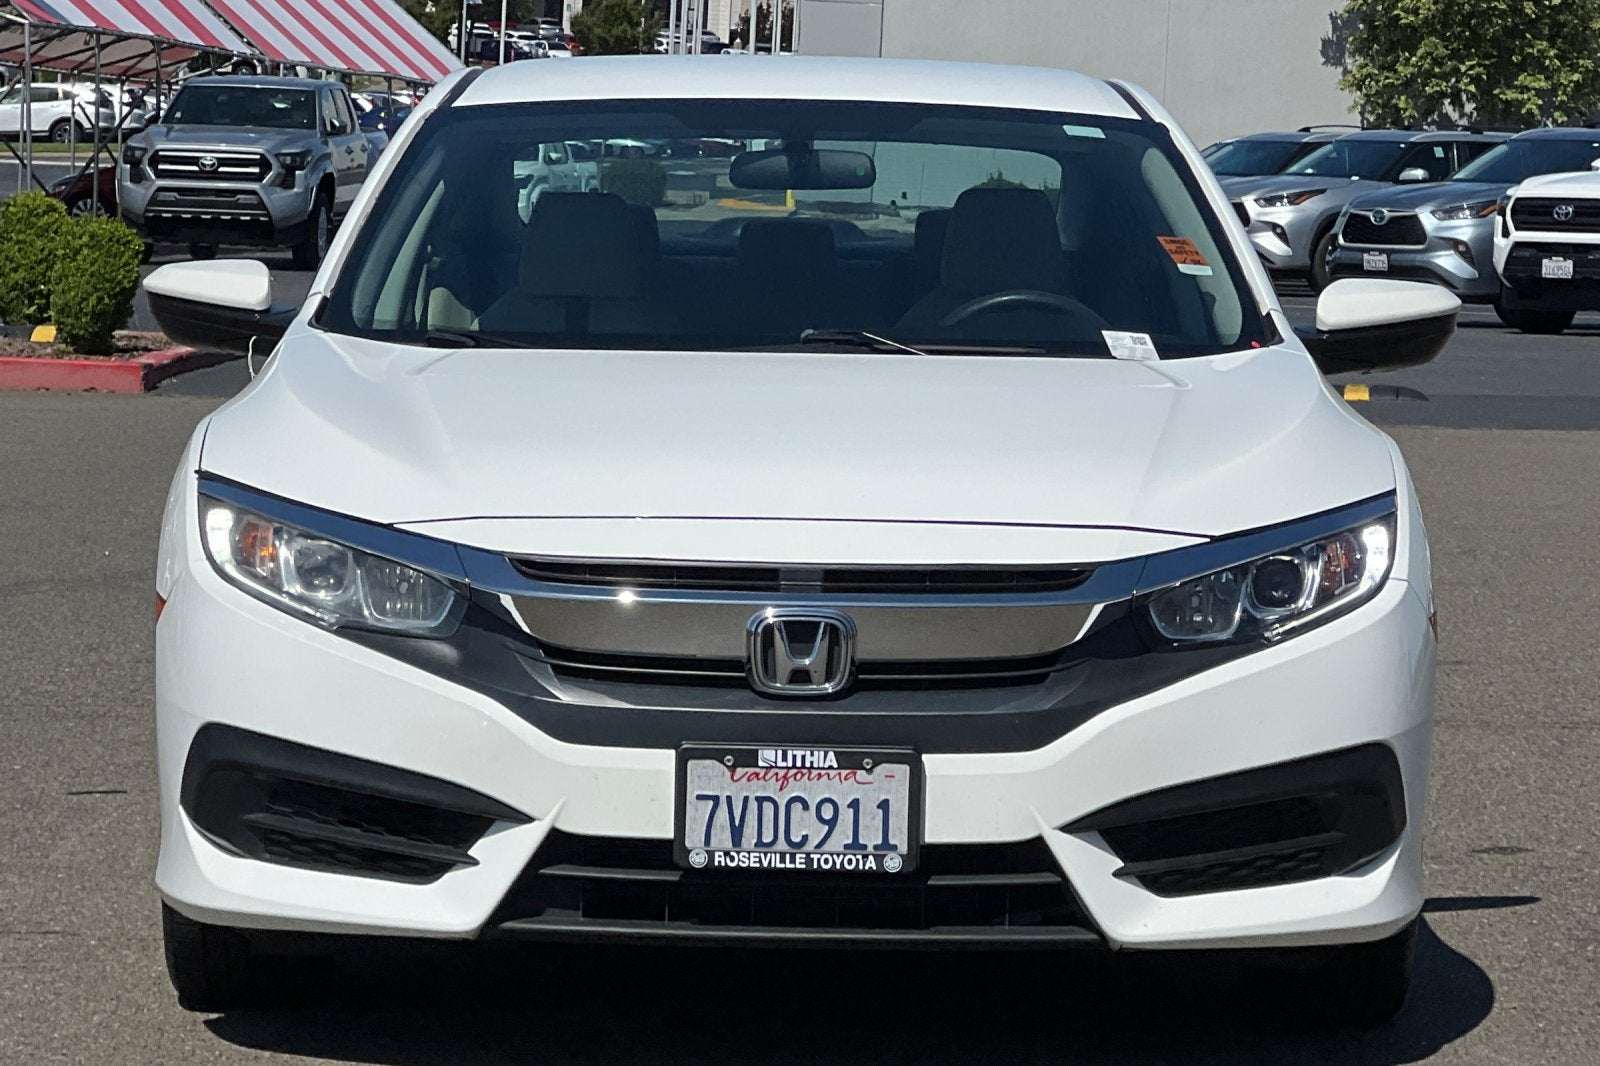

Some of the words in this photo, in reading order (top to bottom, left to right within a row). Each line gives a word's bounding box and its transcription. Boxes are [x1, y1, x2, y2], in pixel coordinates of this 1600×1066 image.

[776, 749, 838, 769] LITHIA
[730, 767, 874, 792] California
[695, 794, 898, 851] 7VDC911
[714, 852, 806, 869] ROSEVILLE
[810, 853, 877, 871] TOYOTA
